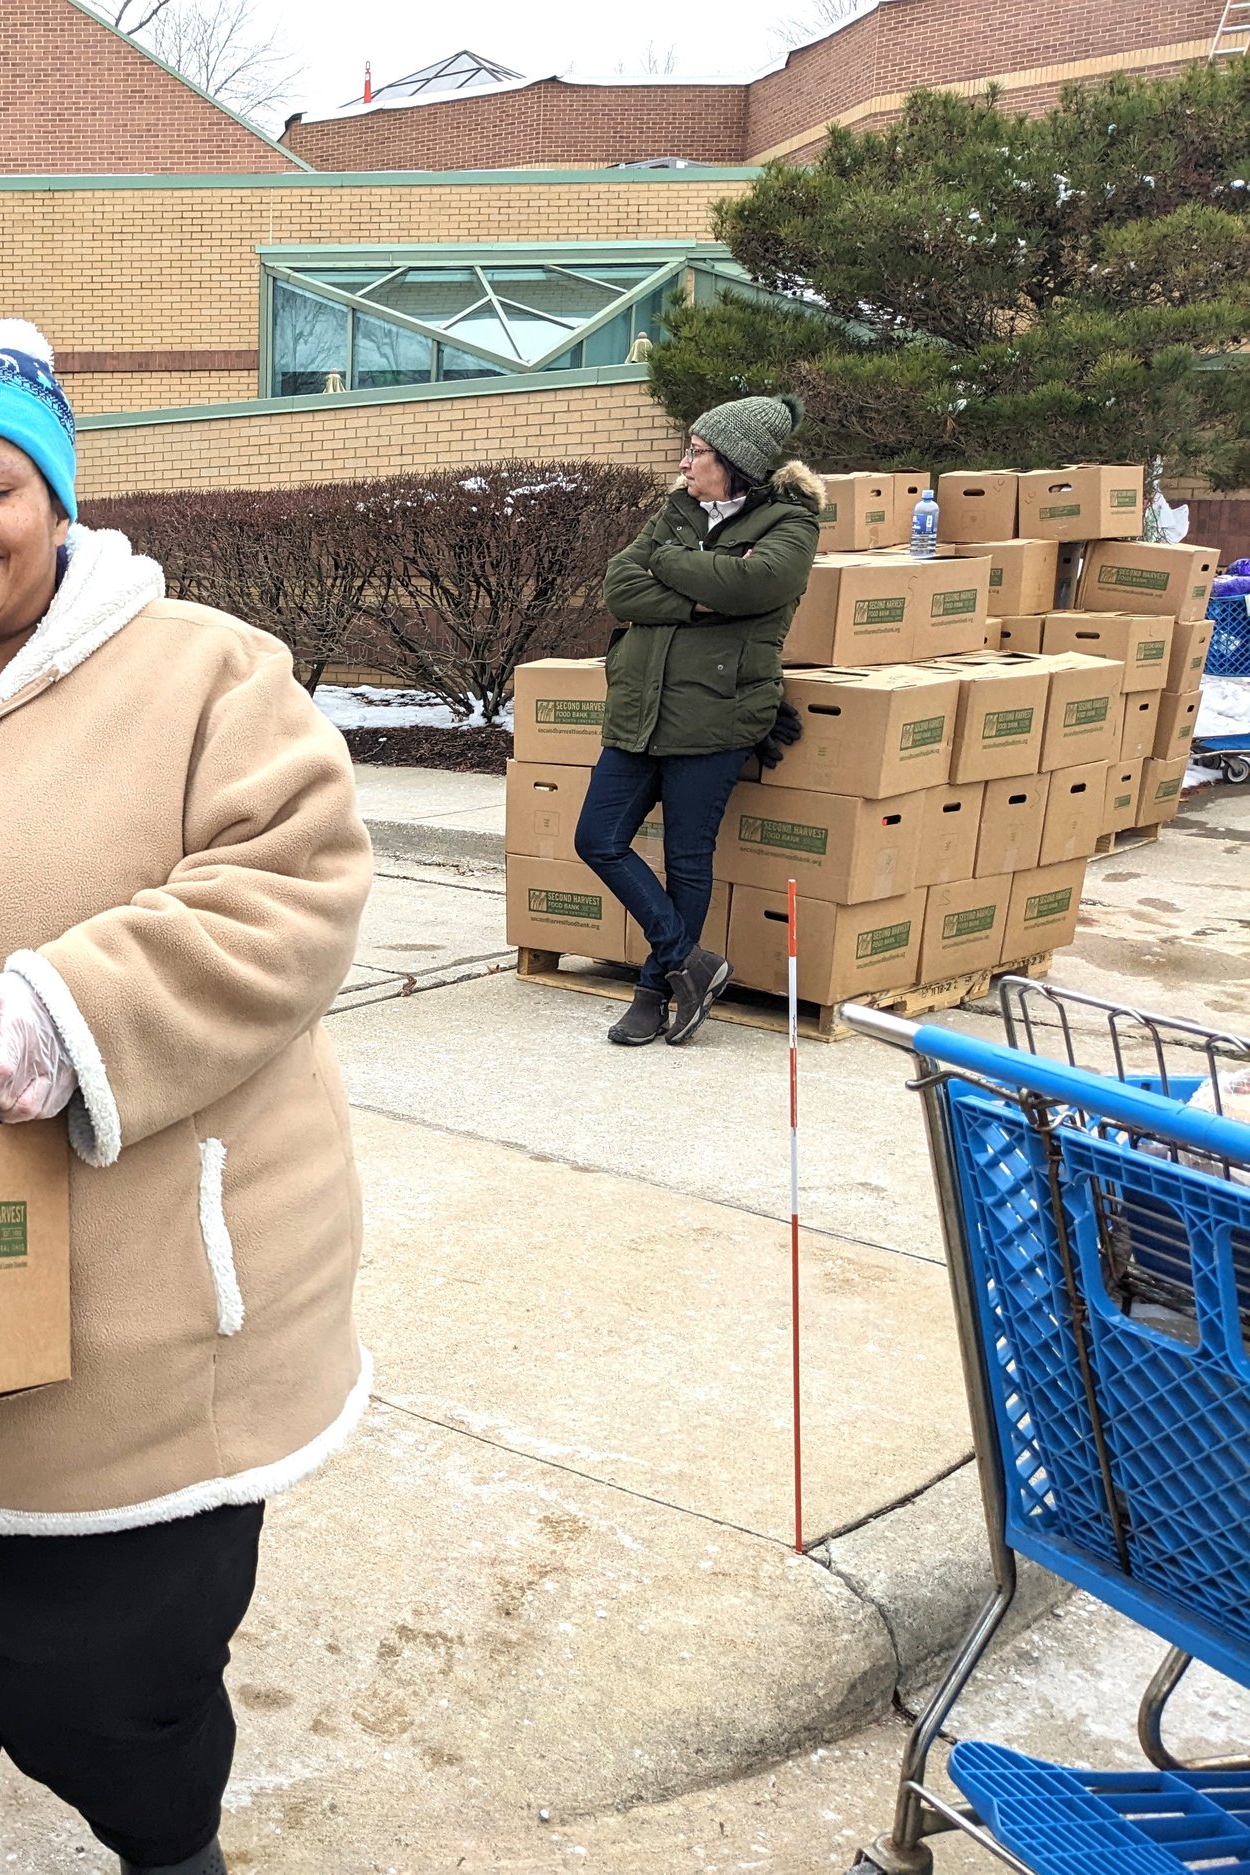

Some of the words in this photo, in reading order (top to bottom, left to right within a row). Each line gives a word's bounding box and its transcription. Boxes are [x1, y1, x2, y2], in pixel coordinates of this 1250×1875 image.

[556, 701, 580, 710] SECOND
[582, 702, 606, 712] HARVES
[764, 821, 792, 832] SECOND
[794, 826, 826, 839] HARVEST
[782, 834, 800, 842] BANK
[548, 893, 571, 902] SECOND
[573, 895, 600, 906] HARVEST
